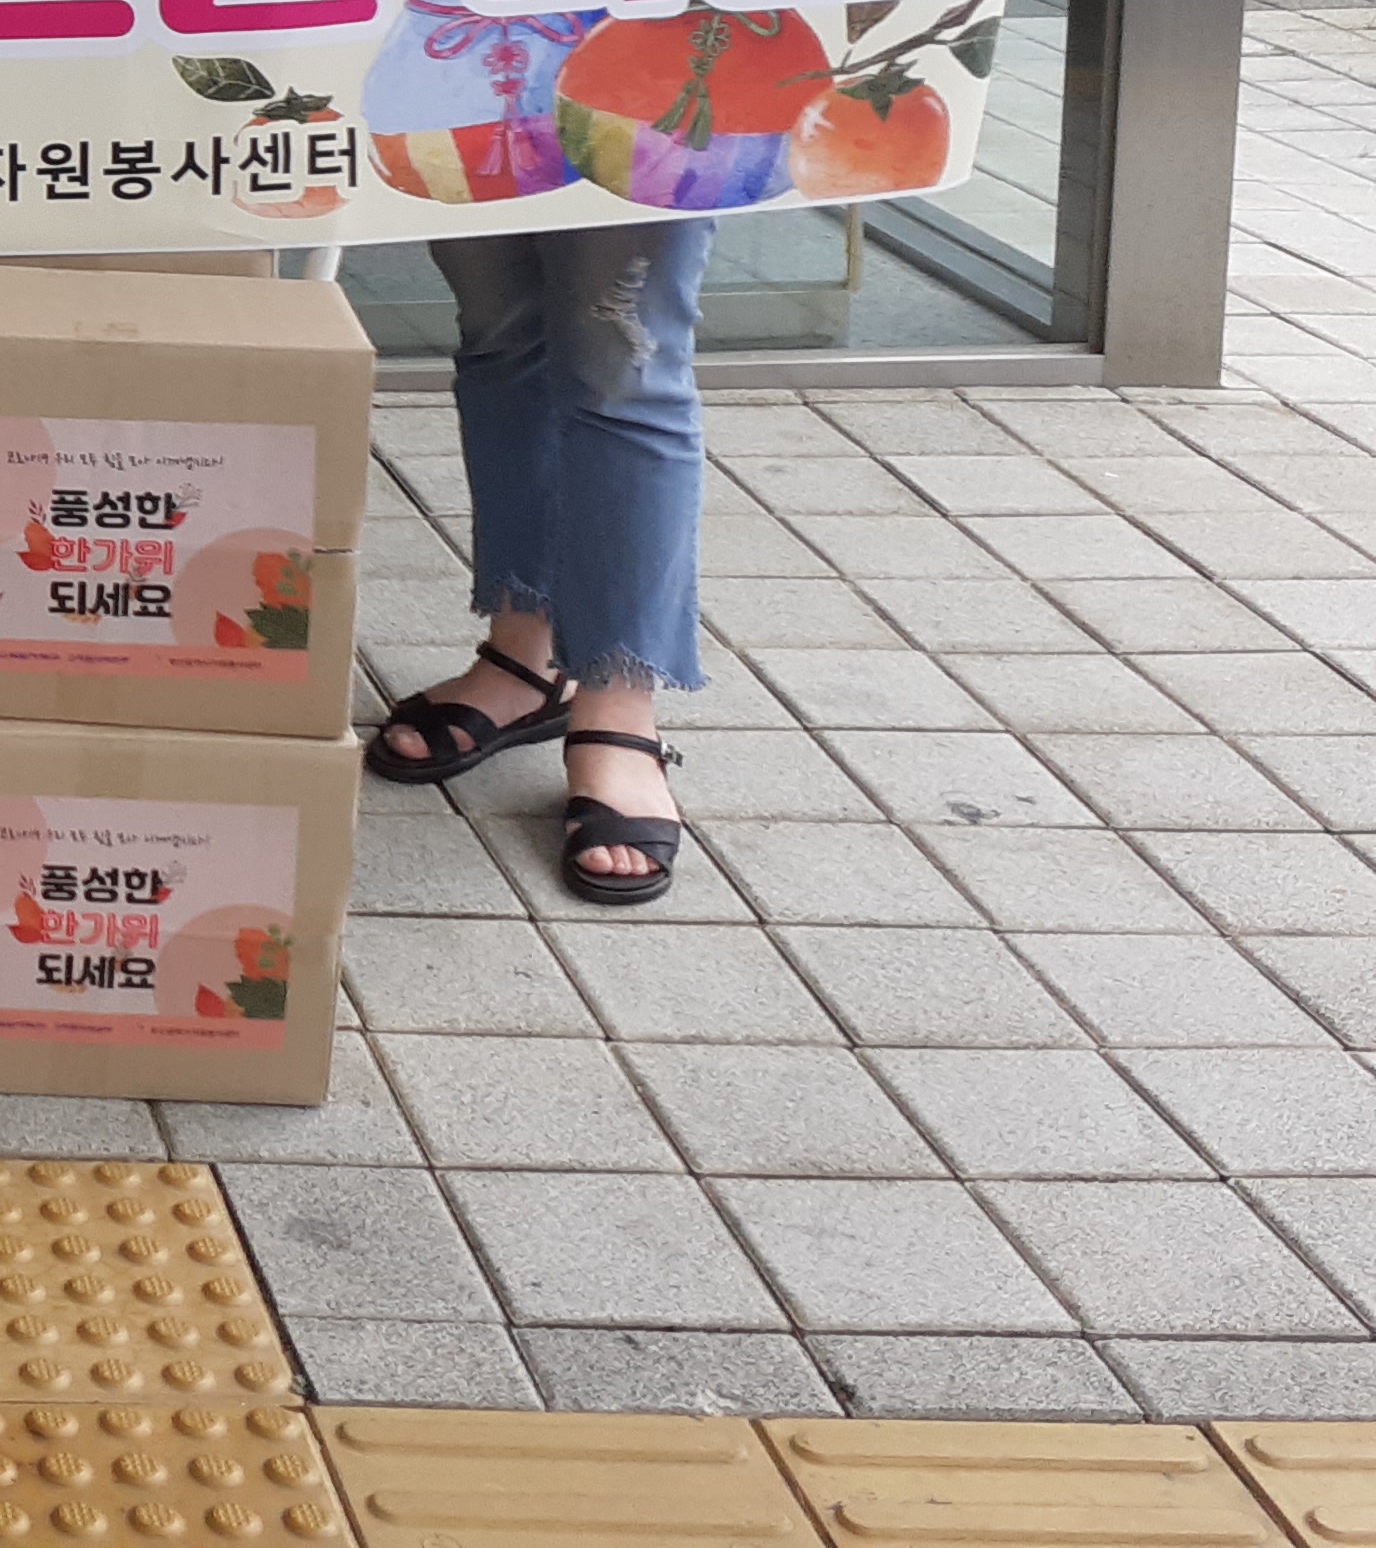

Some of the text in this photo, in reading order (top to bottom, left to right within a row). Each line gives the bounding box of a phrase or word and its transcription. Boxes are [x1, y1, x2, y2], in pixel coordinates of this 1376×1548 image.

[50, 489, 176, 530] 풍성한
[50, 537, 174, 576] 한가위
[49, 581, 172, 618] 되세요
[41, 863, 165, 905] 풍성한
[40, 910, 160, 949] 한가위
[36, 953, 156, 989] 되세요
